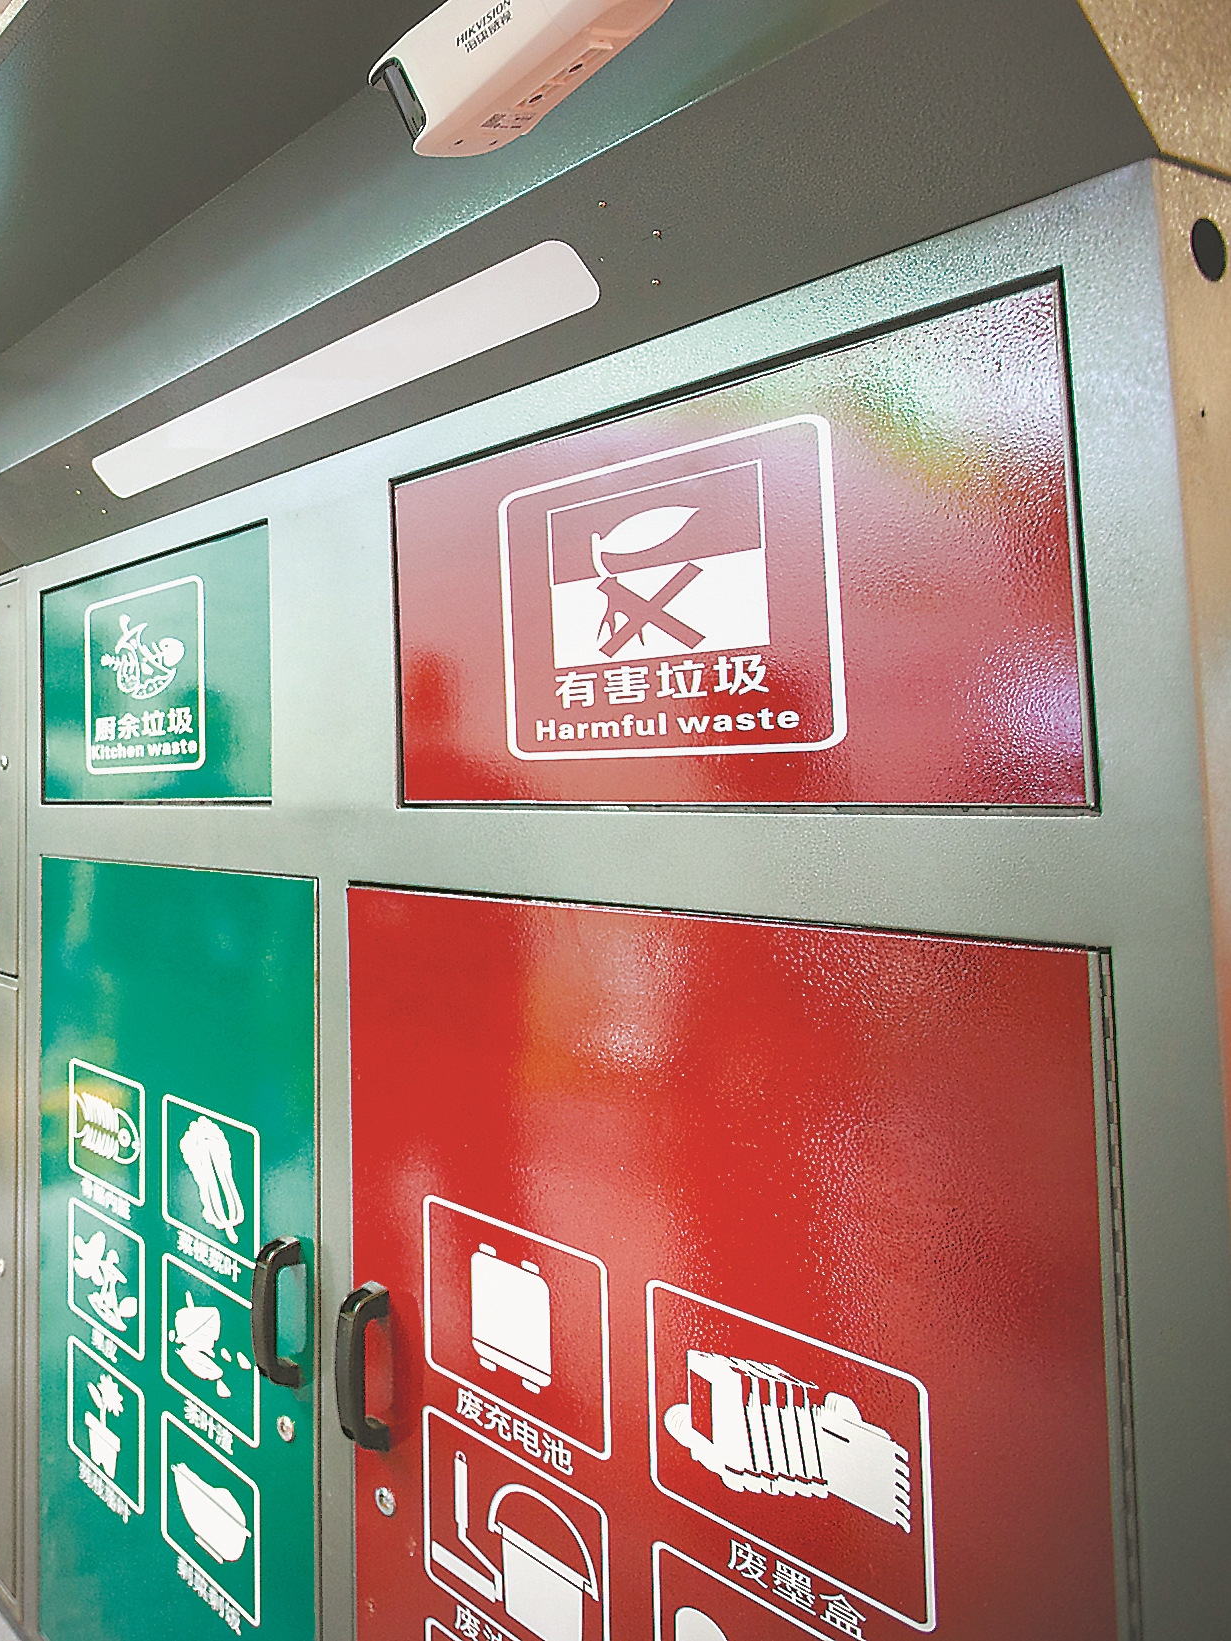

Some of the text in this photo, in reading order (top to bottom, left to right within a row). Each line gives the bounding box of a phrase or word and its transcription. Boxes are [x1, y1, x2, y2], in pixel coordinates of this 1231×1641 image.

[456, 0, 511, 47] HIKVISION
[555, 654, 770, 709] 有害垃圾
[94, 706, 194, 743] 厨余垃圾
[535, 707, 801, 742] Harmful waste
[91, 738, 198, 761] Kitchen waste
[455, 1387, 575, 1476] 废充电池
[727, 1539, 867, 1641] 废墨盒
